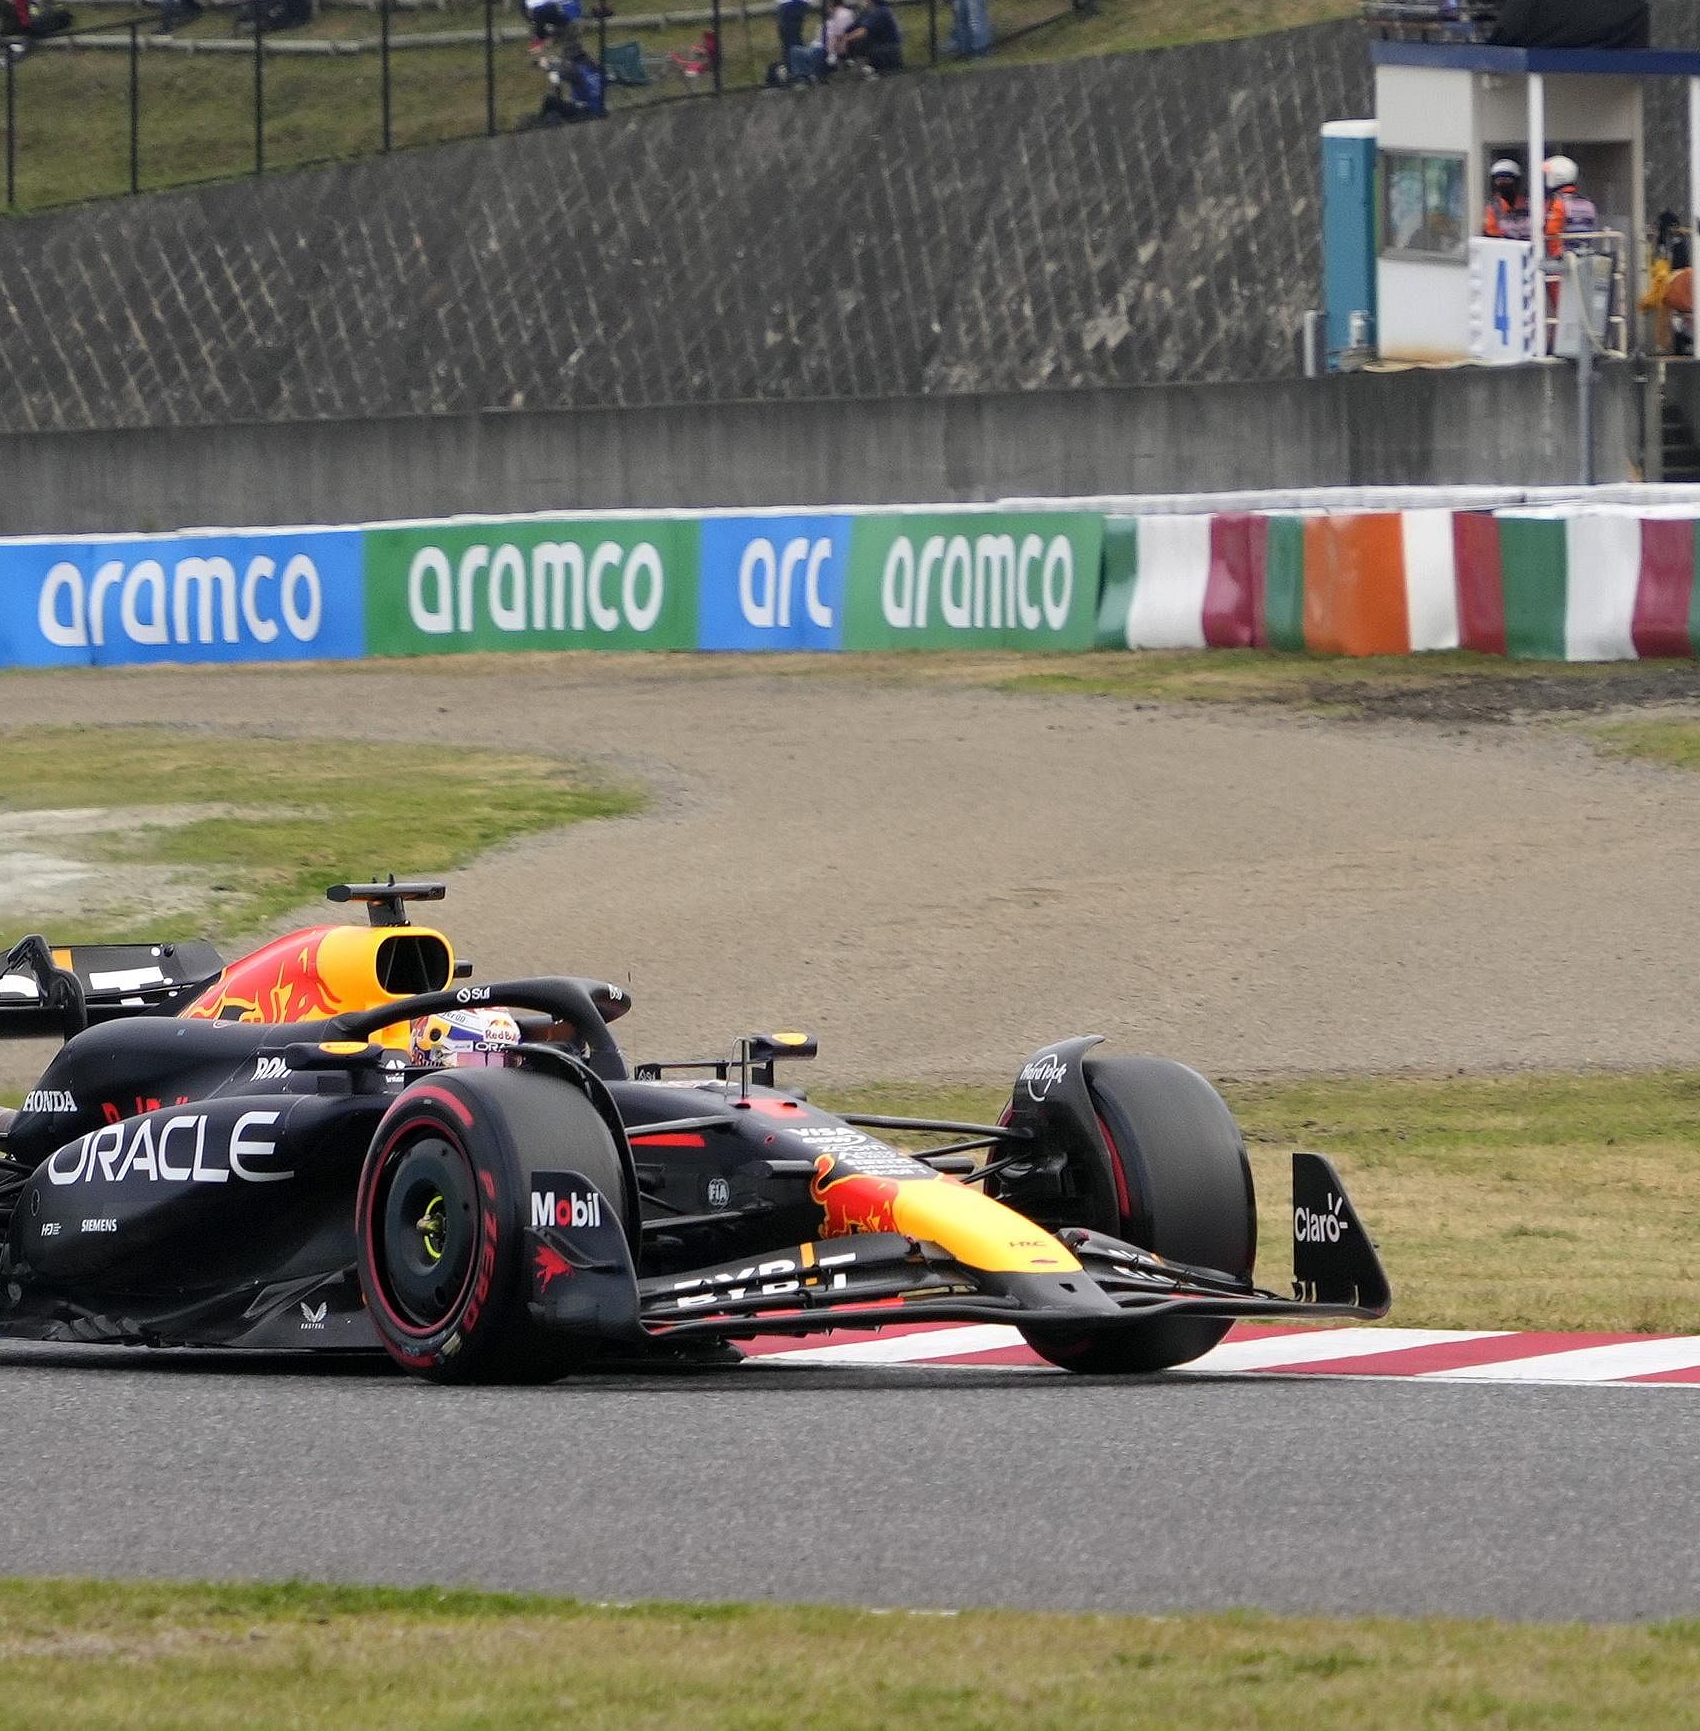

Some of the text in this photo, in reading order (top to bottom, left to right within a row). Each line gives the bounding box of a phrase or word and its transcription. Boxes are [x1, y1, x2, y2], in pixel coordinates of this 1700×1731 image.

[1494, 259, 1509, 346] 4
[38, 553, 321, 647] aramco
[409, 540, 664, 634] aramco
[882, 533, 1073, 631] aramco
[22, 1090, 78, 1112] HONDA
[48, 1111, 295, 1185] ORACLE
[81, 1218, 118, 1233] SIEMENS
[531, 1191, 600, 1228] Mobil
[1295, 1204, 1341, 1243] Claro
